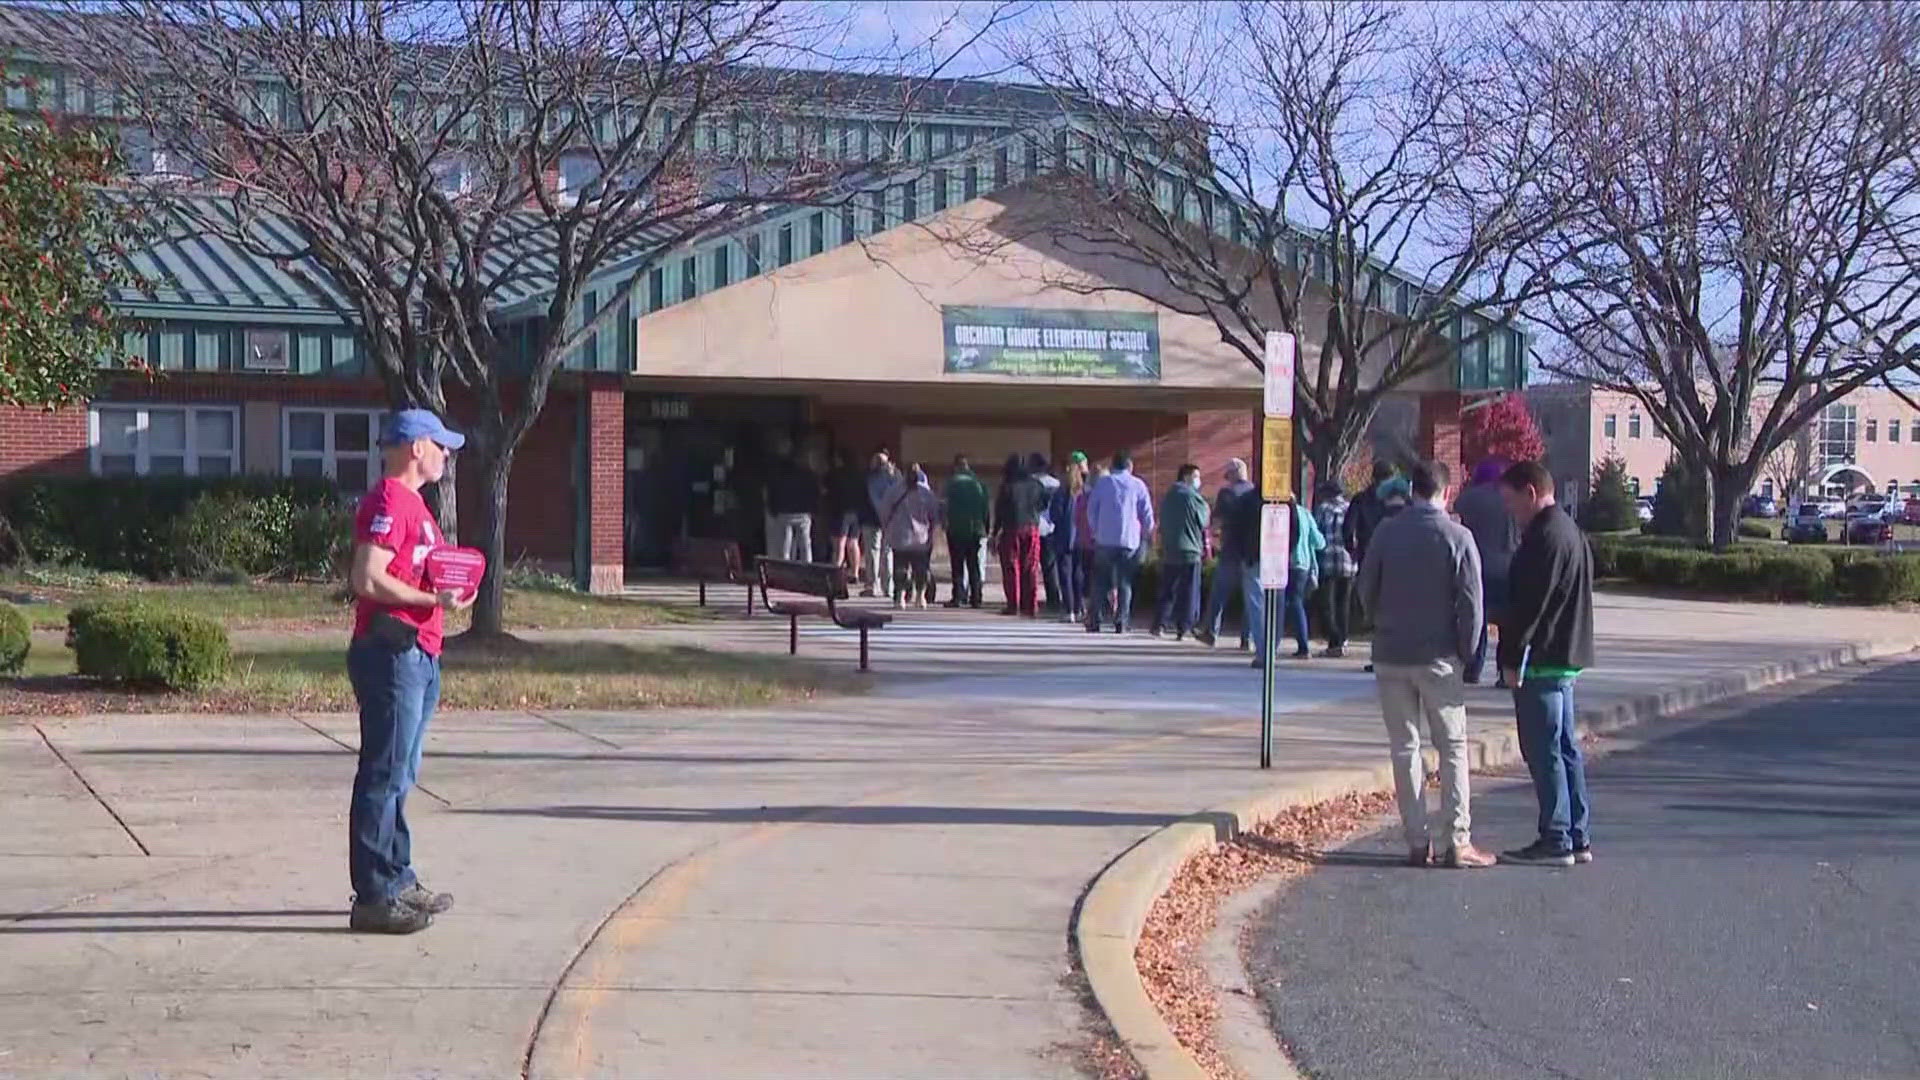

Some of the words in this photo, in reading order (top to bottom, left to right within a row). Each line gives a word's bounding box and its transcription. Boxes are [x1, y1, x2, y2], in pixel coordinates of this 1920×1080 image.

[955, 325, 1004, 346] ORCHARD
[1006, 327, 1041, 348] GROVE
[1043, 328, 1107, 350] ELEMENTARY
[1109, 330, 1150, 352] SCHOOL
